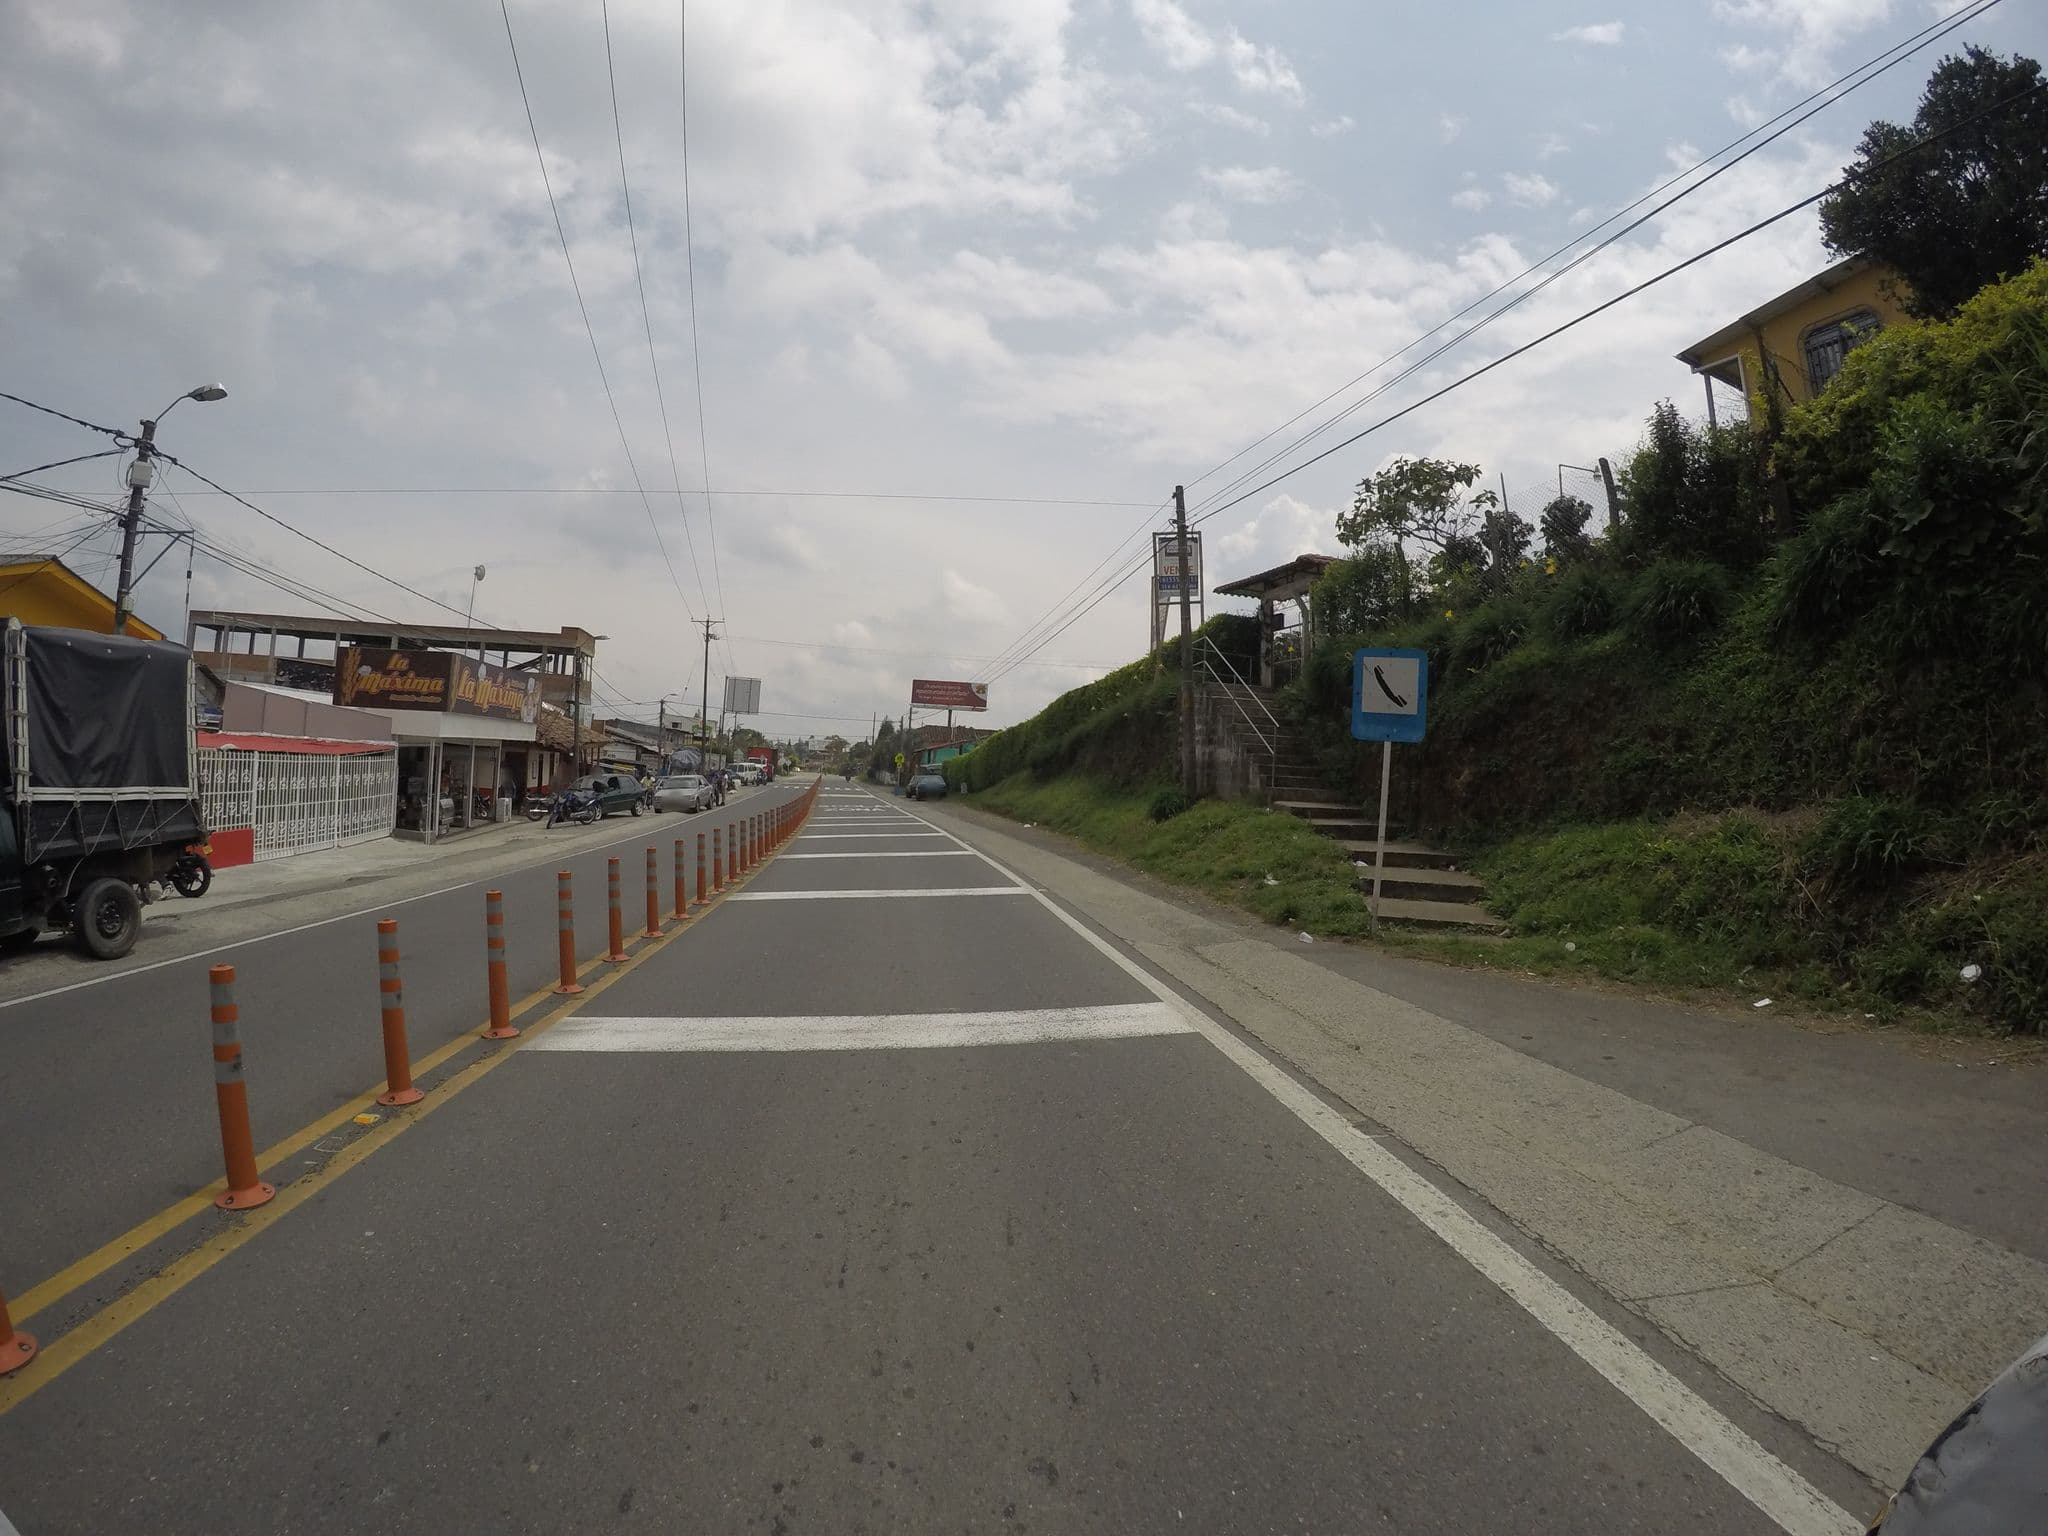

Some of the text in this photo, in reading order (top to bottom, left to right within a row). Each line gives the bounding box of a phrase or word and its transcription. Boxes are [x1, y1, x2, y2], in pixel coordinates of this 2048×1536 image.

[1164, 565, 1195, 575] VENE
[386, 653, 410, 671] La
[457, 665, 475, 701] La
